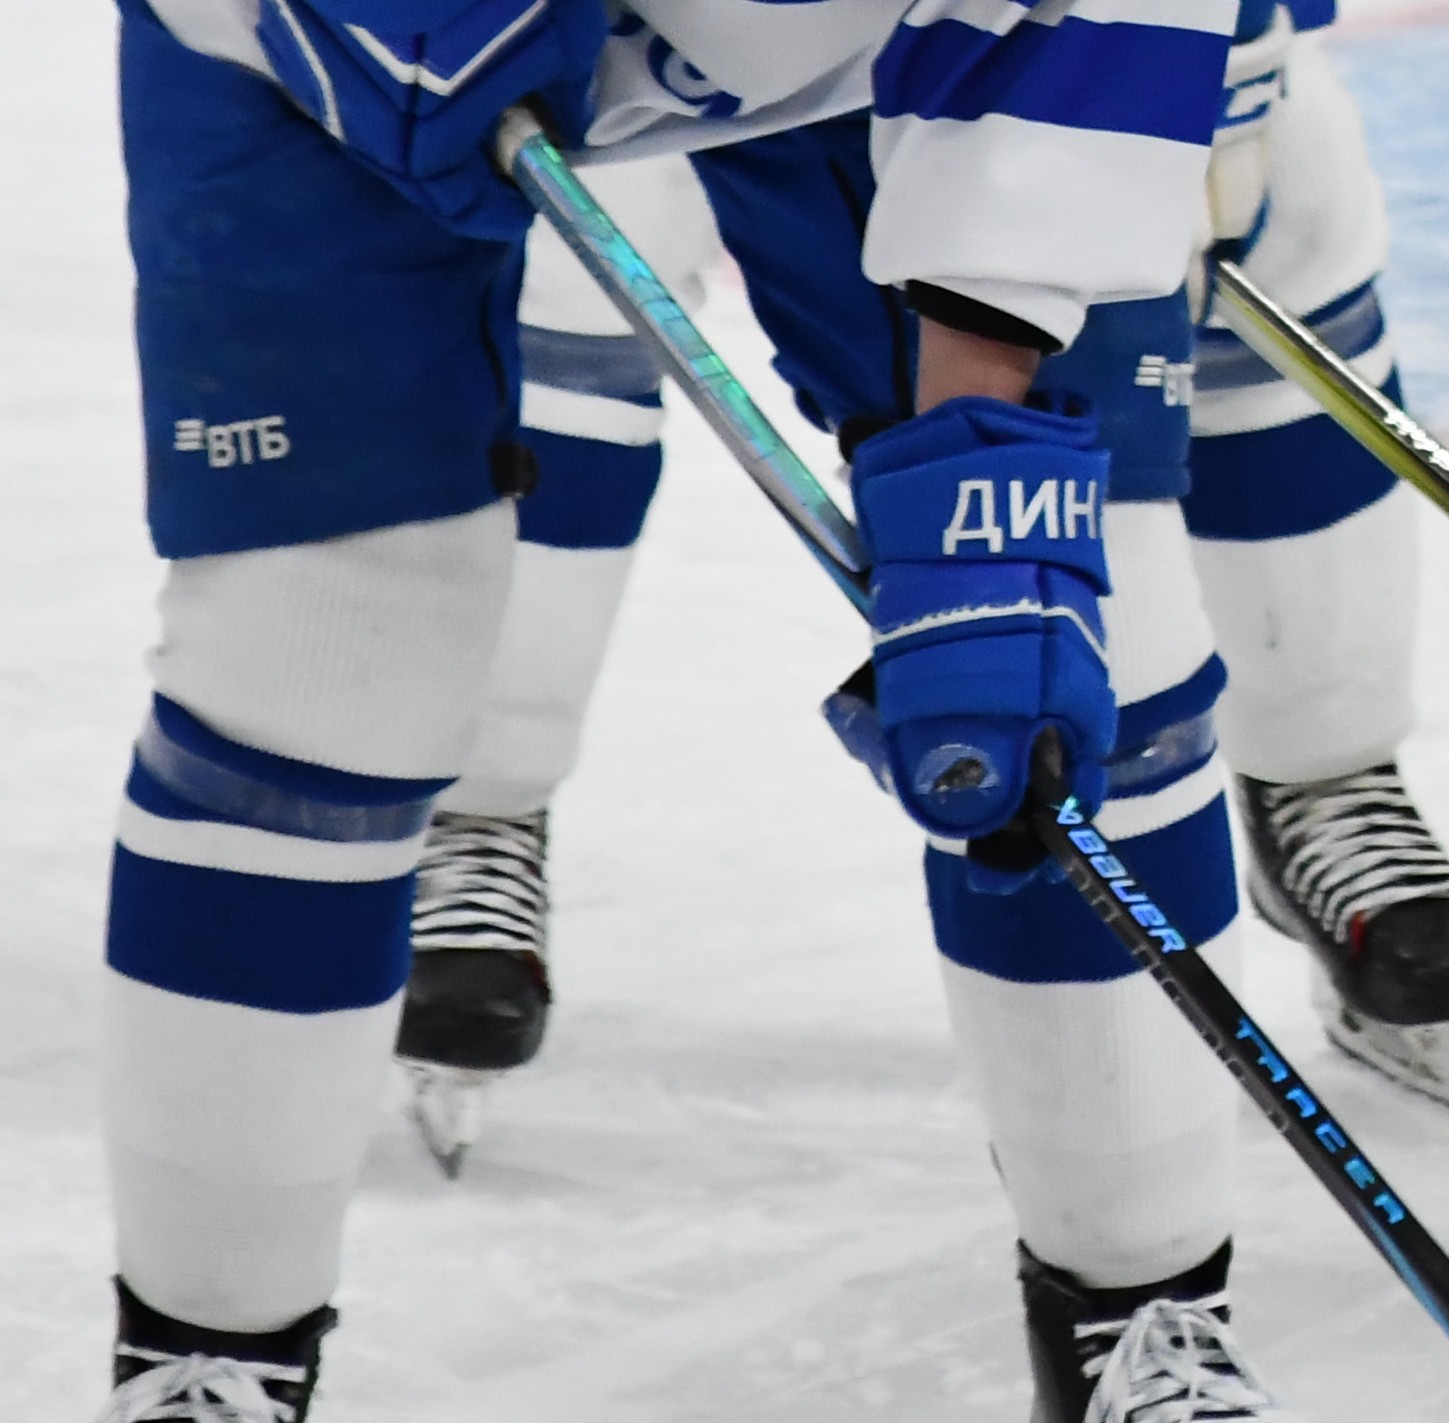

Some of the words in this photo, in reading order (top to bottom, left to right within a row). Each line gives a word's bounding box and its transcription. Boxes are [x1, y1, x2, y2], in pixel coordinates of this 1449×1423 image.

[207, 414, 291, 468] ВТБ
[1067, 826, 1188, 955] BAUER
[1234, 1016, 1407, 1226] TRACER
